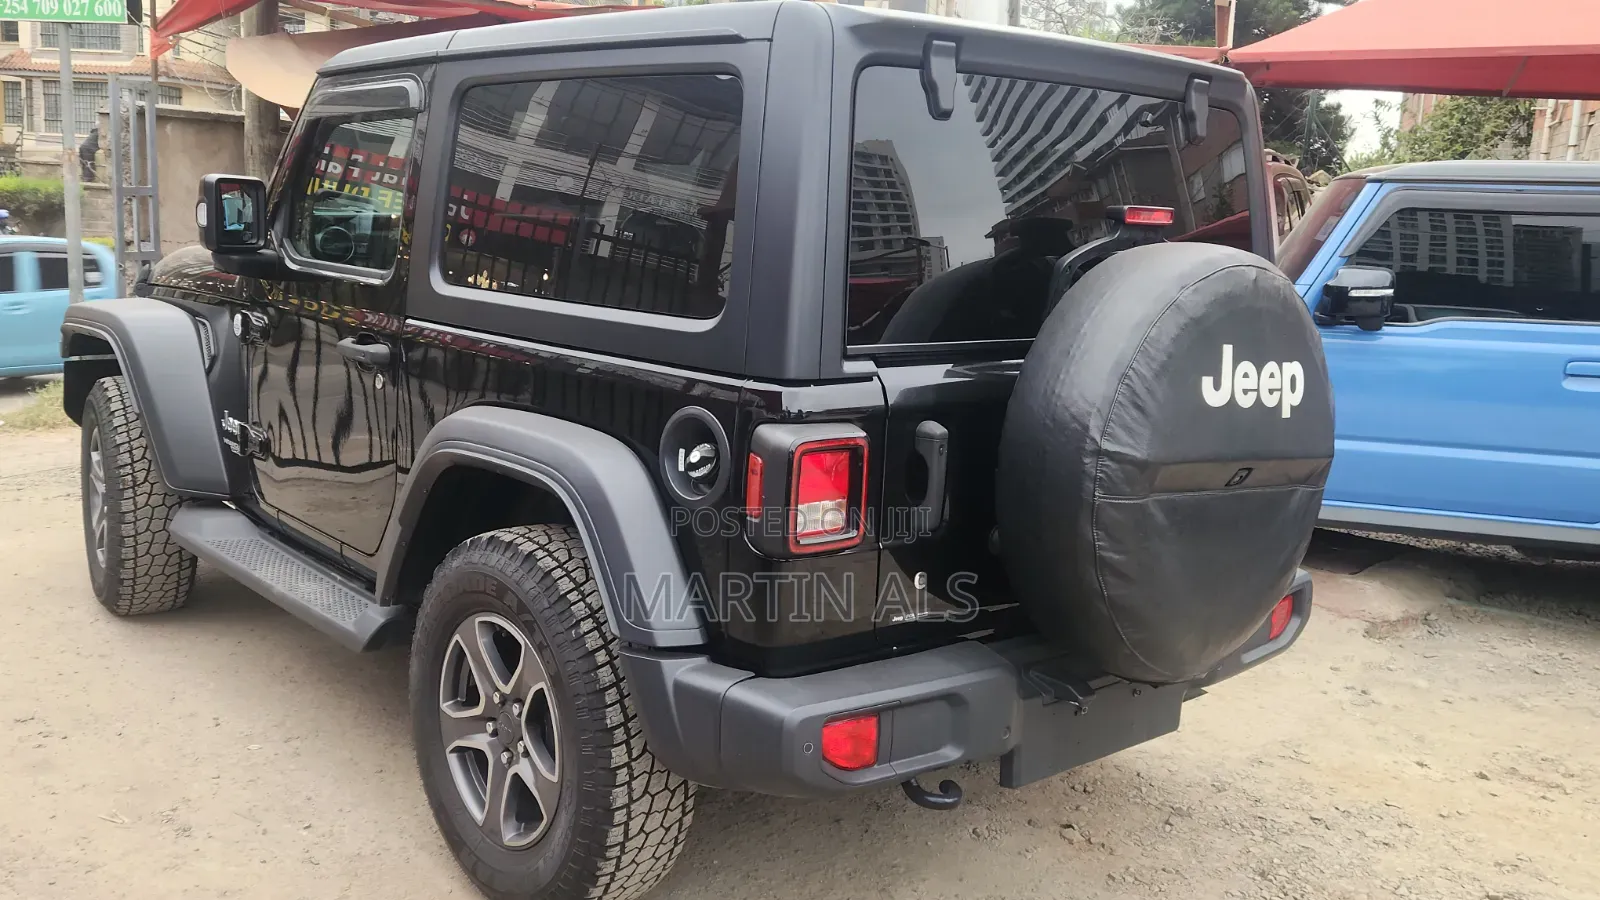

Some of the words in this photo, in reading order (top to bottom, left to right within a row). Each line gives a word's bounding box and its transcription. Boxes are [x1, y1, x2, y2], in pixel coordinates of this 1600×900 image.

[33, 0, 58, 15] 709
[63, 0, 89, 16] 027
[94, 0, 122, 17] 600
[1201, 343, 1305, 419] Jeep
